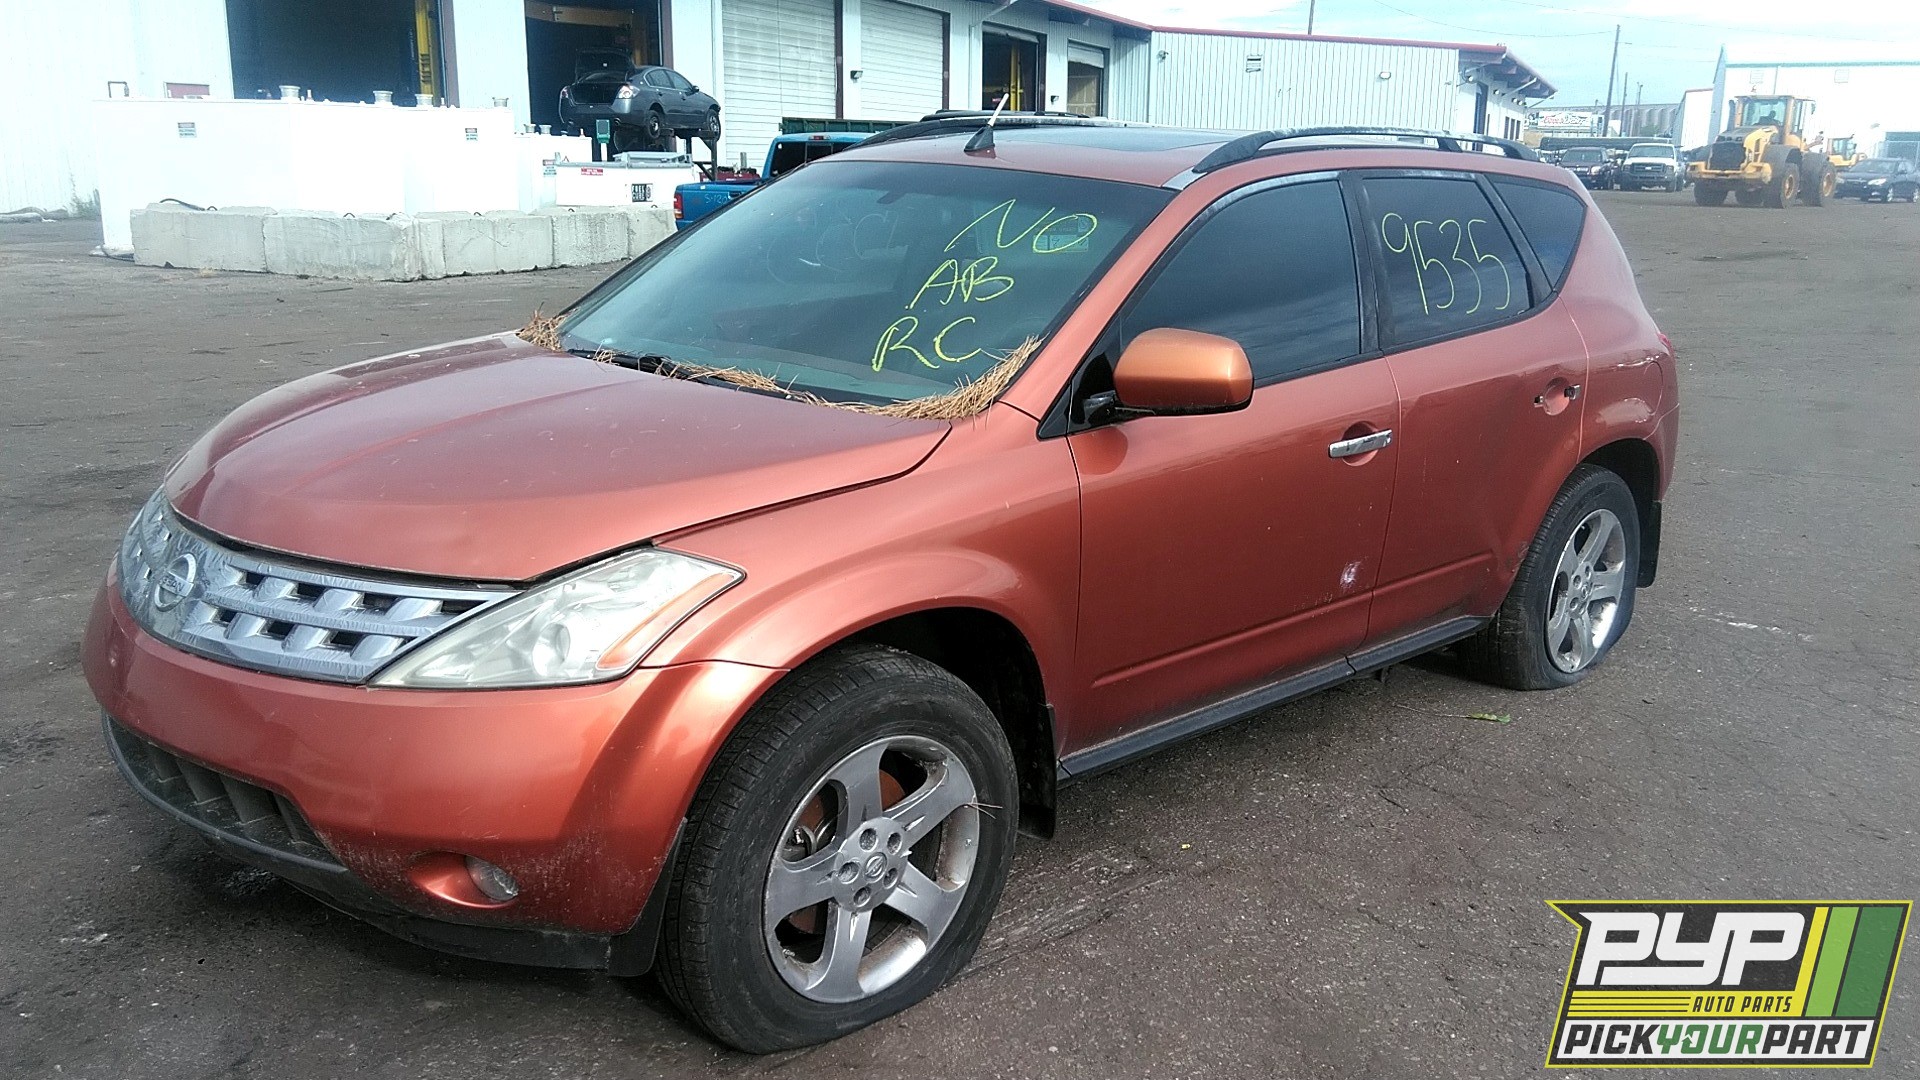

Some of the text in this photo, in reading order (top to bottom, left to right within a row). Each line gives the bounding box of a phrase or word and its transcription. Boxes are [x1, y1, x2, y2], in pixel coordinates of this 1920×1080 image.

[943, 198, 1098, 254] NO
[904, 255, 1015, 310] AB
[1381, 212, 1511, 316] 9535
[871, 315, 982, 372] RC
